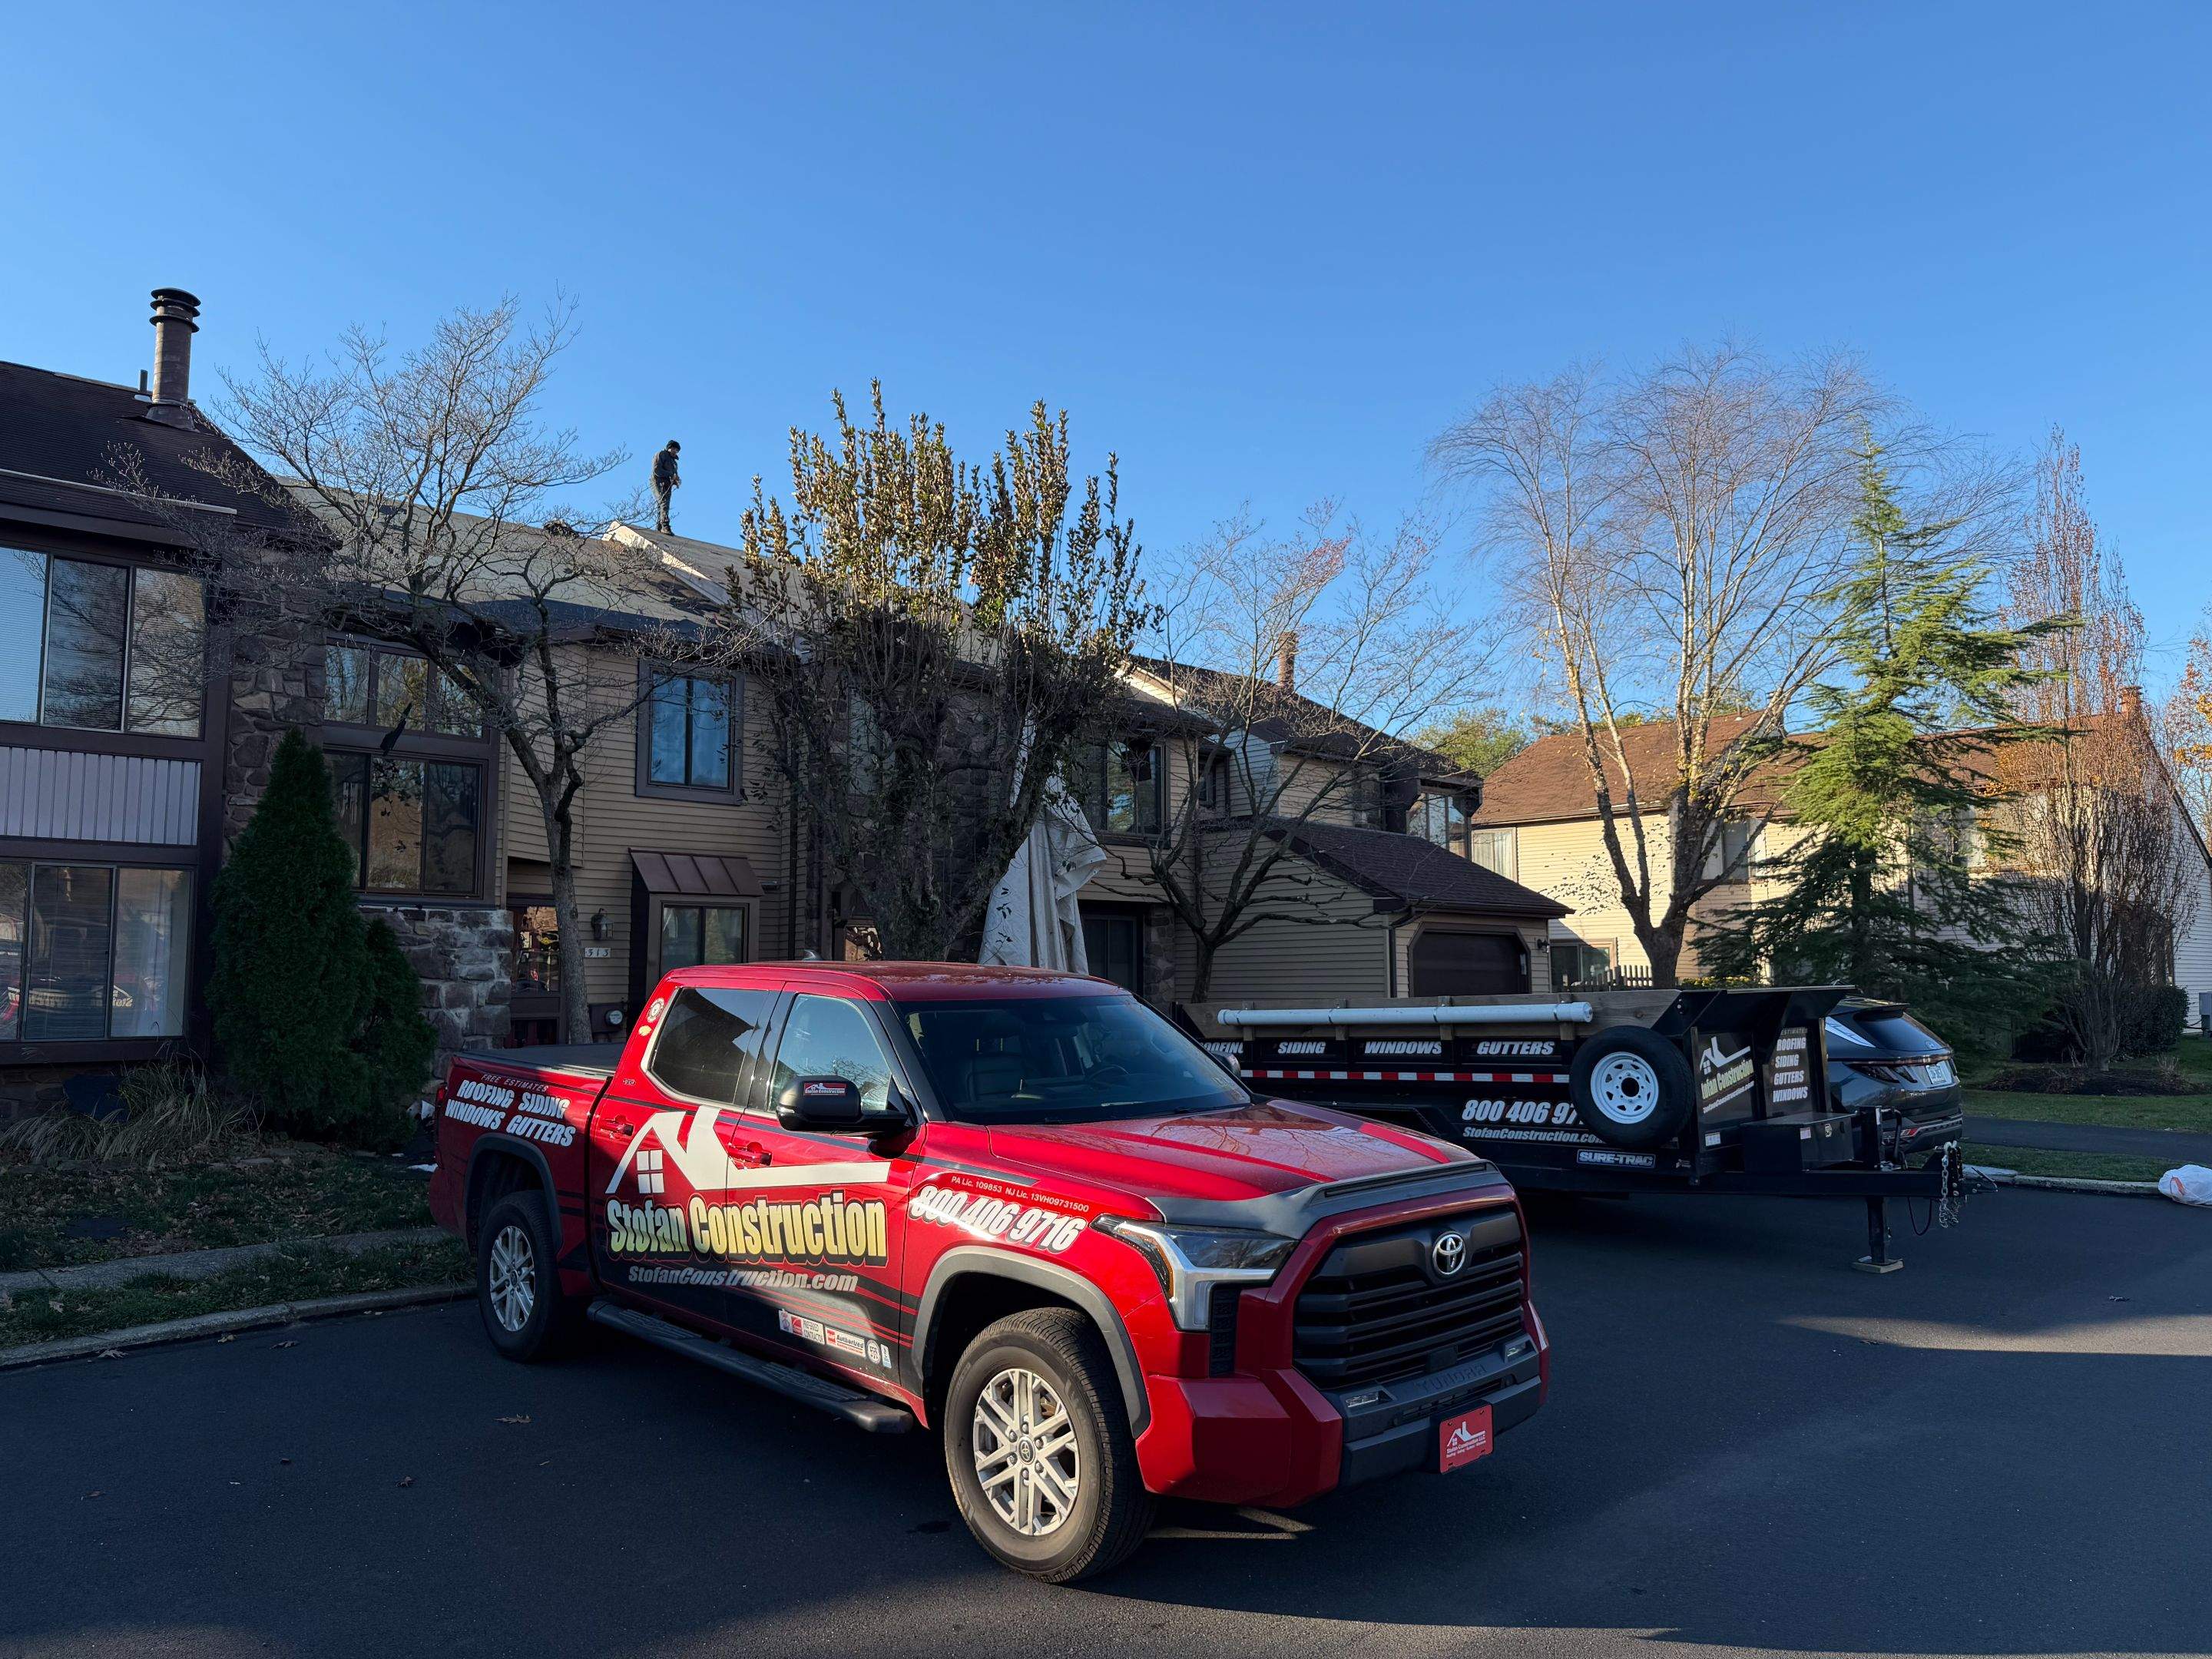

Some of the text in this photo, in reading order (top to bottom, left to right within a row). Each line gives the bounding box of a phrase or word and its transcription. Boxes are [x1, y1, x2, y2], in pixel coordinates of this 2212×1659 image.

[1277, 1041, 1326, 1054] SIDING
[1364, 1041, 1442, 1055] WINDOWS
[1476, 1041, 1555, 1055] GUTTERS
[1777, 1037, 1806, 1051] ROOFING
[1775, 1055, 1800, 1068] SIDING
[481, 1074, 549, 1092] FREE ESTIMATES
[1700, 1059, 1754, 1100] tofan Construction
[1773, 1070, 1805, 1085] GUTTERS
[456, 1079, 571, 1119] ROOFING SIDING
[1773, 1086, 1808, 1103] WINDOWS
[1462, 1099, 1584, 1125] 800 406 97
[445, 1098, 577, 1147] WINDOWS GUTTERS
[1578, 1151, 1654, 1167] SURE-TRAC
[951, 1176, 1090, 1213] PA Lic. 109853 NJ Lic. 13VH09731500
[606, 1191, 887, 1257] Stofan Construction
[910, 1185, 1088, 1251] 800 406 9716
[628, 1265, 859, 1292] StofanConstruction.com
[836, 1334, 864, 1349] Authorized
